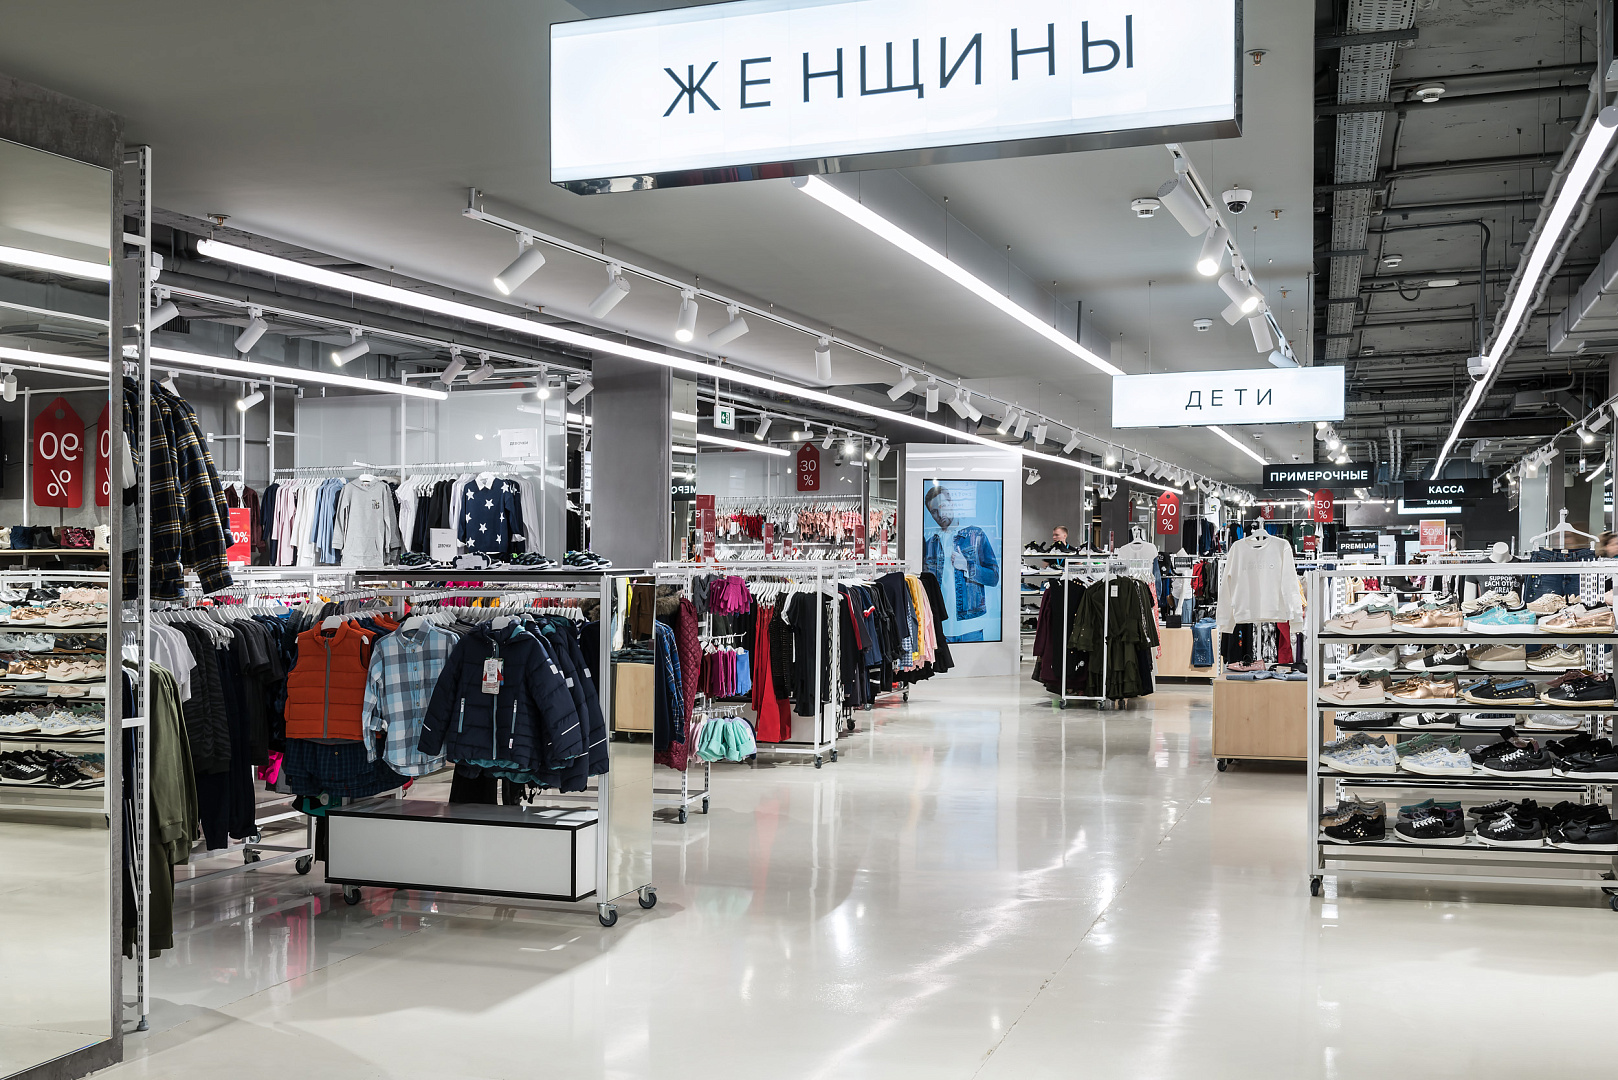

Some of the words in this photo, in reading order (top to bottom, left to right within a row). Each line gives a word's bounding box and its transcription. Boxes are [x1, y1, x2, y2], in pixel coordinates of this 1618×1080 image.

[662, 14, 1134, 117] ЖЕНЩИНЫ
[1185, 388, 1272, 410] ДЕТИ
[803, 474, 814, 486] %
[1270, 470, 1368, 482] ПРИМЕРОЧНЫЕ
[1428, 485, 1465, 494] КАССА
[1318, 510, 1328, 519] %
[1162, 518, 1174, 531] %
[231, 531, 249, 544] 0%
[1340, 542, 1376, 550] PREMIUM
